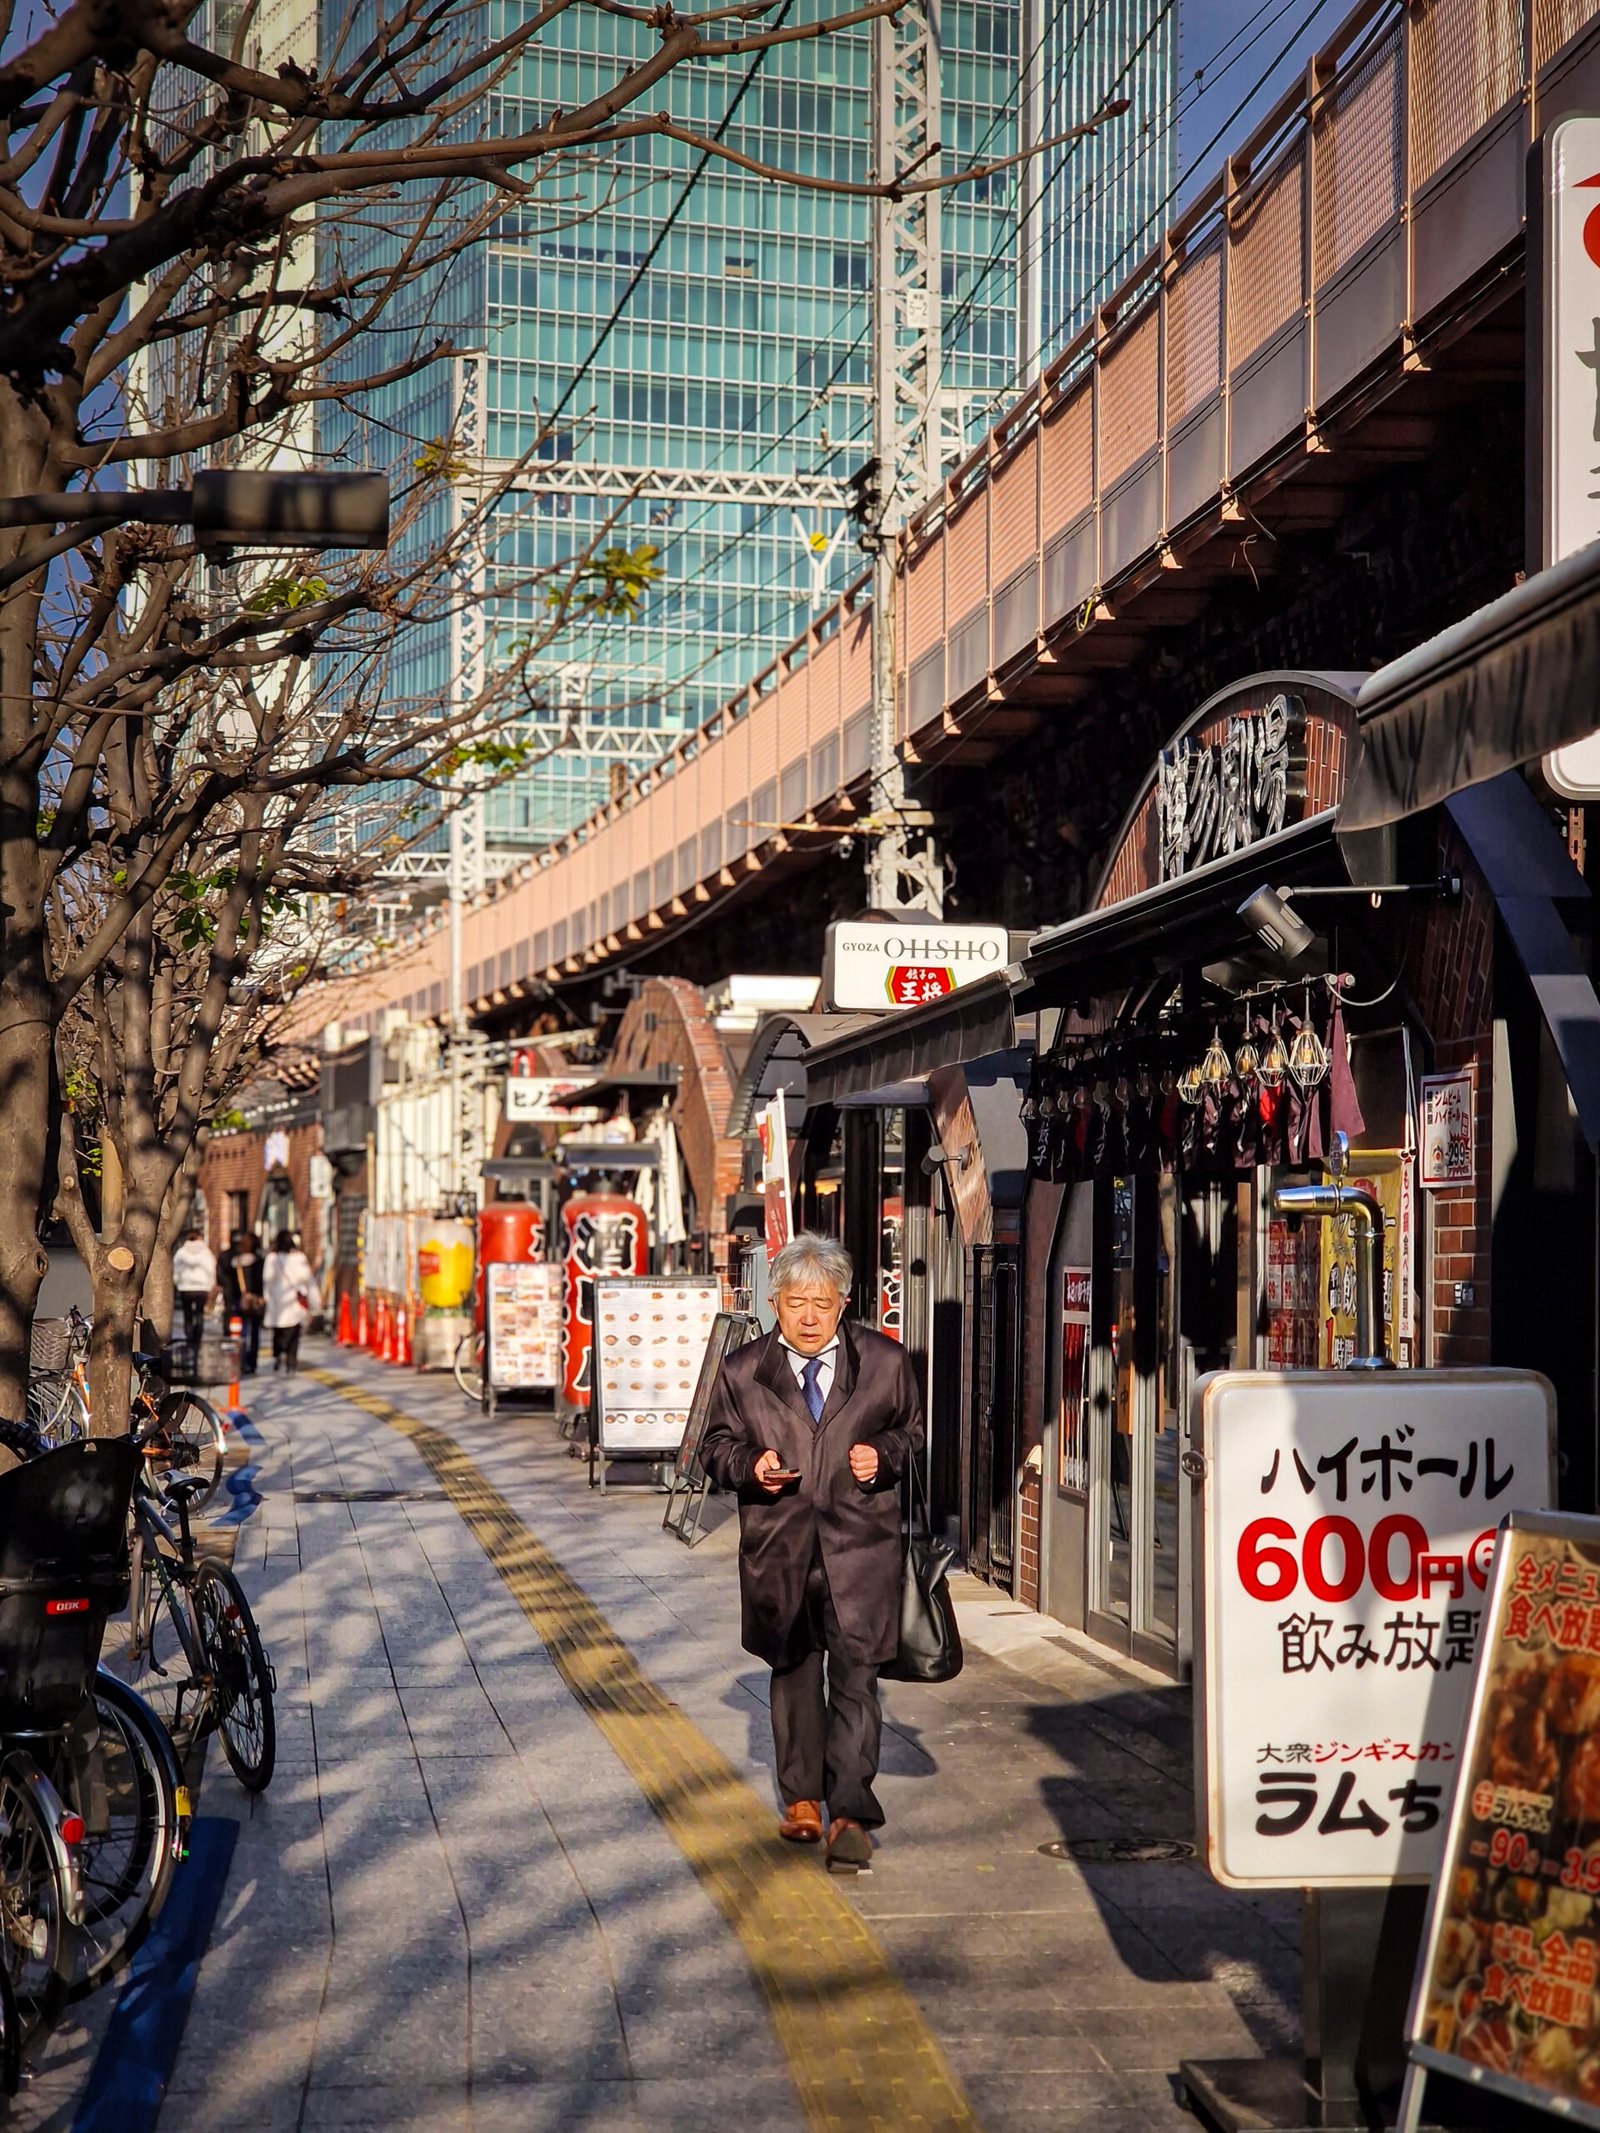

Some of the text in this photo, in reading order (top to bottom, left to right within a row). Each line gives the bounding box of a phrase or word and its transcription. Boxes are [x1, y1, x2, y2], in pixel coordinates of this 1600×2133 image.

[842, 937, 1000, 962] GYOZA OHSHO
[905, 968, 937, 980] 餃子の
[899, 981, 944, 1003] 王将
[1261, 1424, 1514, 1502] ハイボール
[1237, 1514, 1464, 1603] 600円
